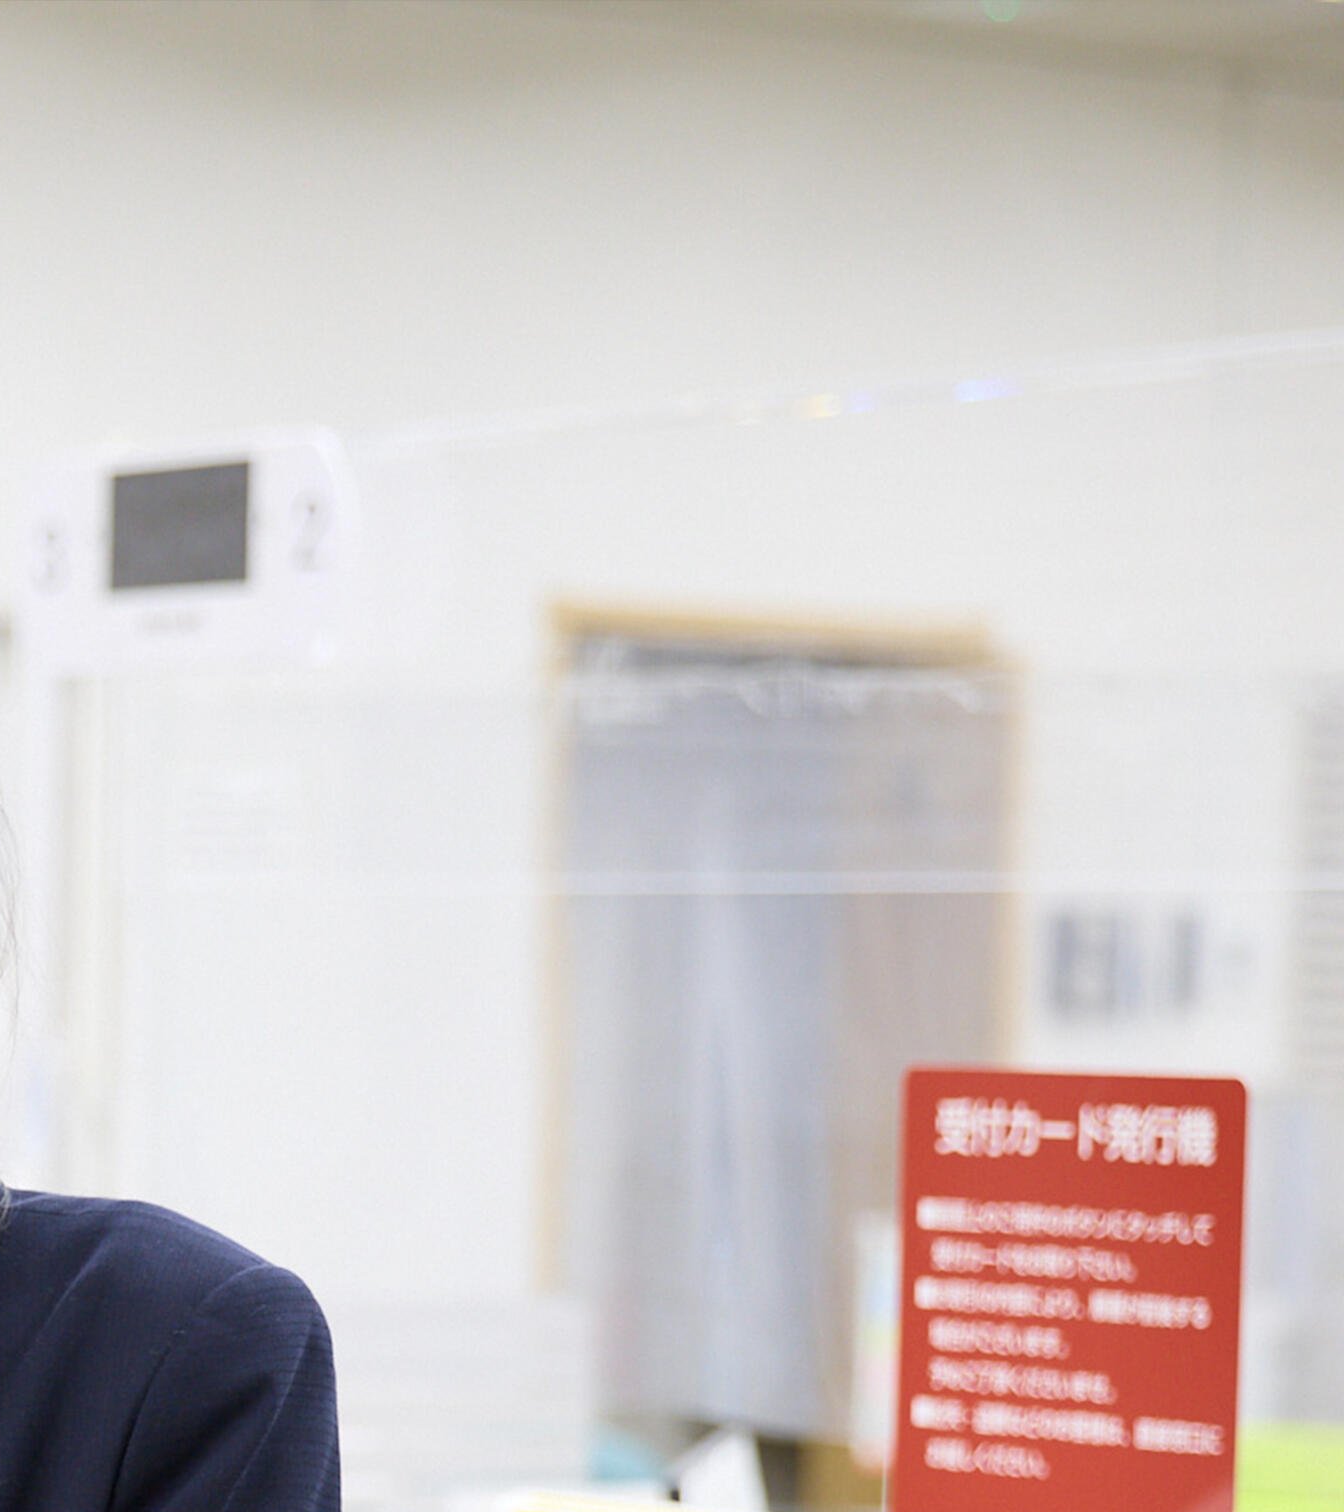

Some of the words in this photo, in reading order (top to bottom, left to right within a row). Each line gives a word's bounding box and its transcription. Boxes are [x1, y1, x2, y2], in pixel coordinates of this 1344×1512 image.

[934, 1097, 1218, 1168] 受付カード発行機
